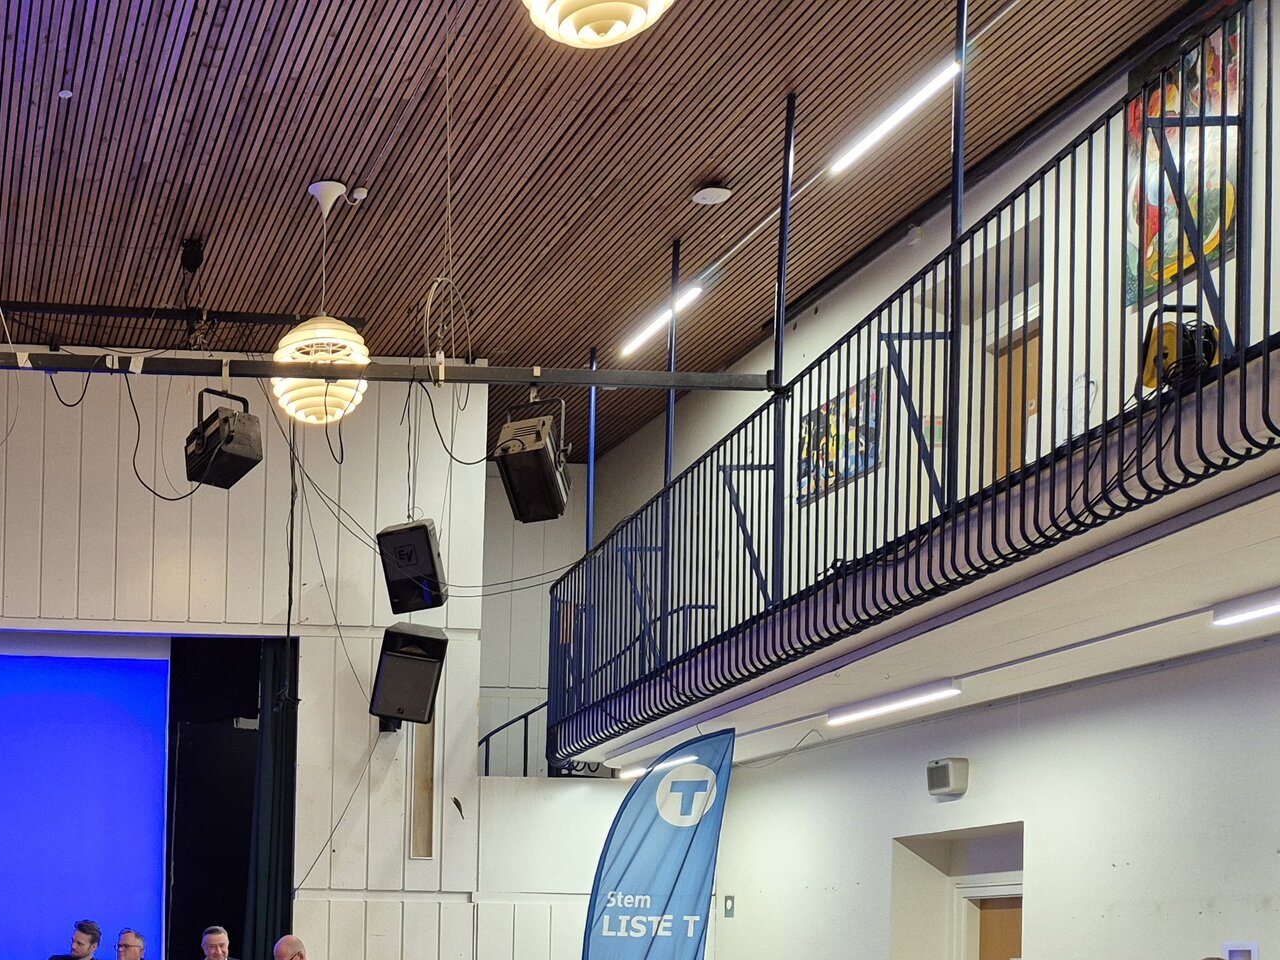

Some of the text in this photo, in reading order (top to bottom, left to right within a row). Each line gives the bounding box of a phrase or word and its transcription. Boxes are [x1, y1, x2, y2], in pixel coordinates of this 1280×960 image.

[670, 779, 708, 816] T
[606, 891, 651, 909] Stem
[602, 914, 700, 937] LISTE T
